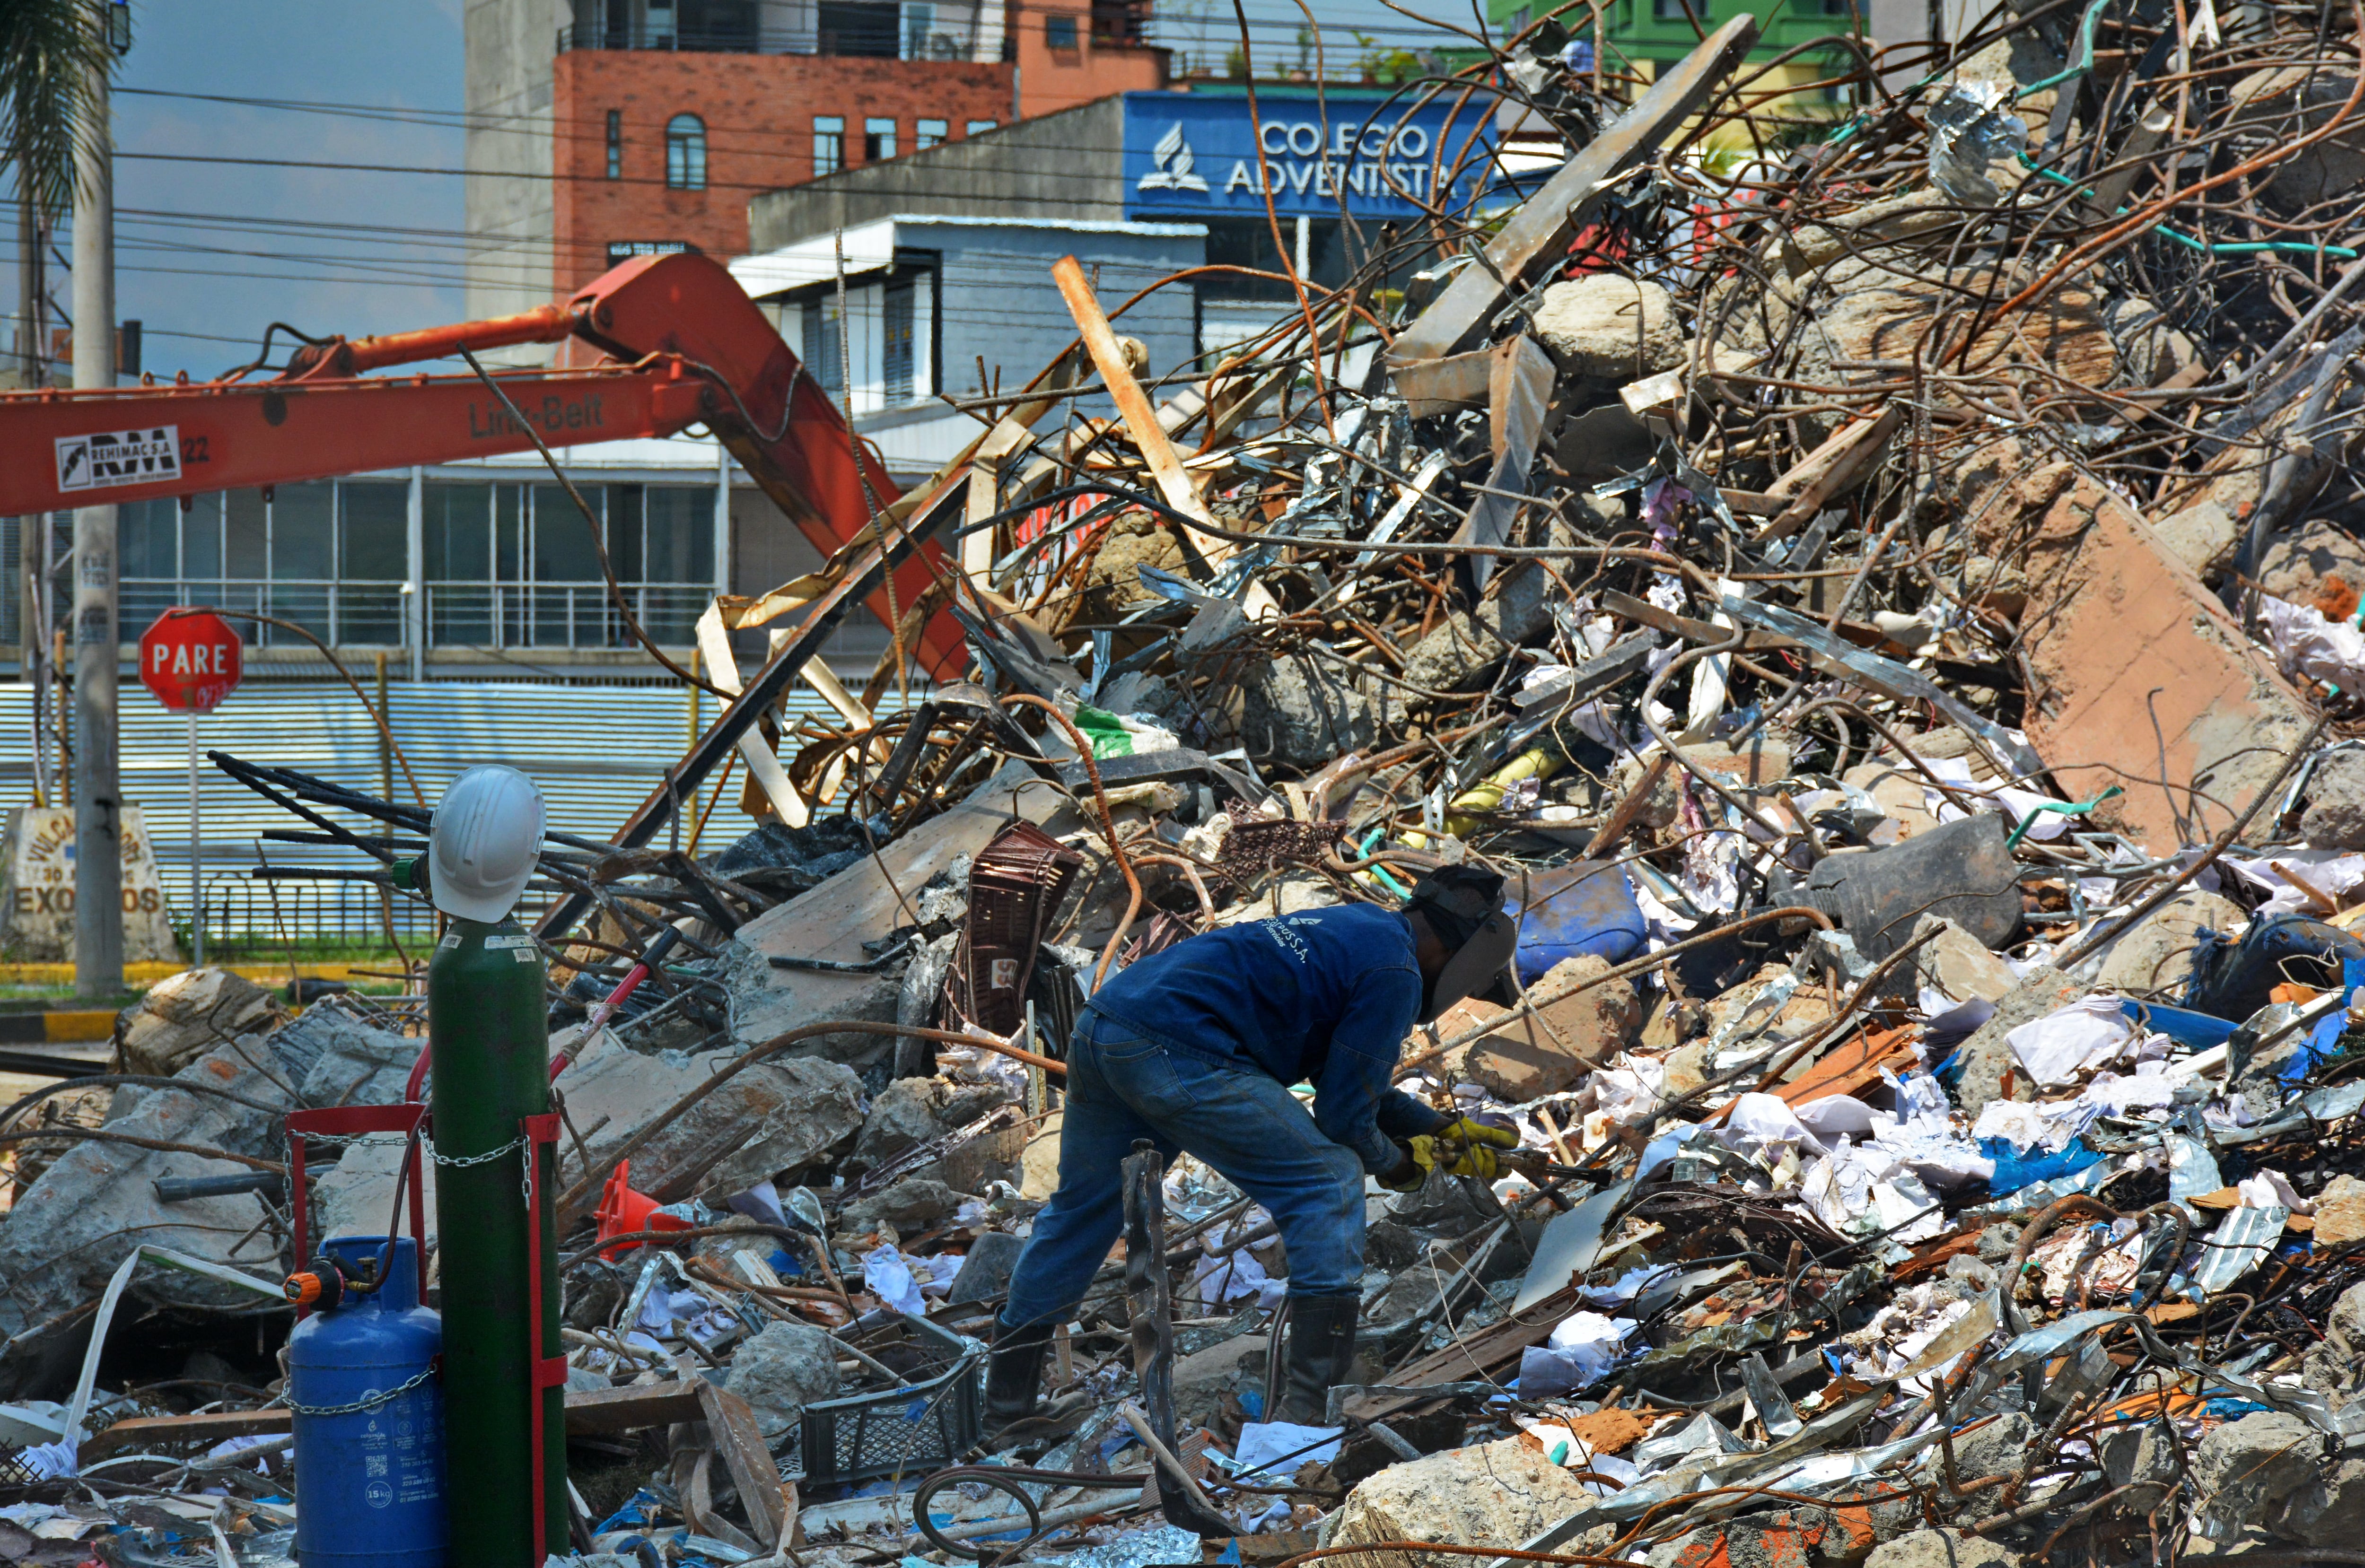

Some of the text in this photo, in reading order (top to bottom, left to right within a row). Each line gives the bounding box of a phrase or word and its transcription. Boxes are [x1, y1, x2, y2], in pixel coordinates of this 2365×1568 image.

[1260, 121, 1428, 158] COLEGIO
[1224, 159, 1457, 199] ADVENTISTA
[91, 443, 148, 461] REHIMAC
[153, 643, 228, 674] PARE
[14, 887, 160, 915] EXOOS
[1290, 938, 1308, 964] S.A.
[368, 1490, 391, 1499] 15 kg
